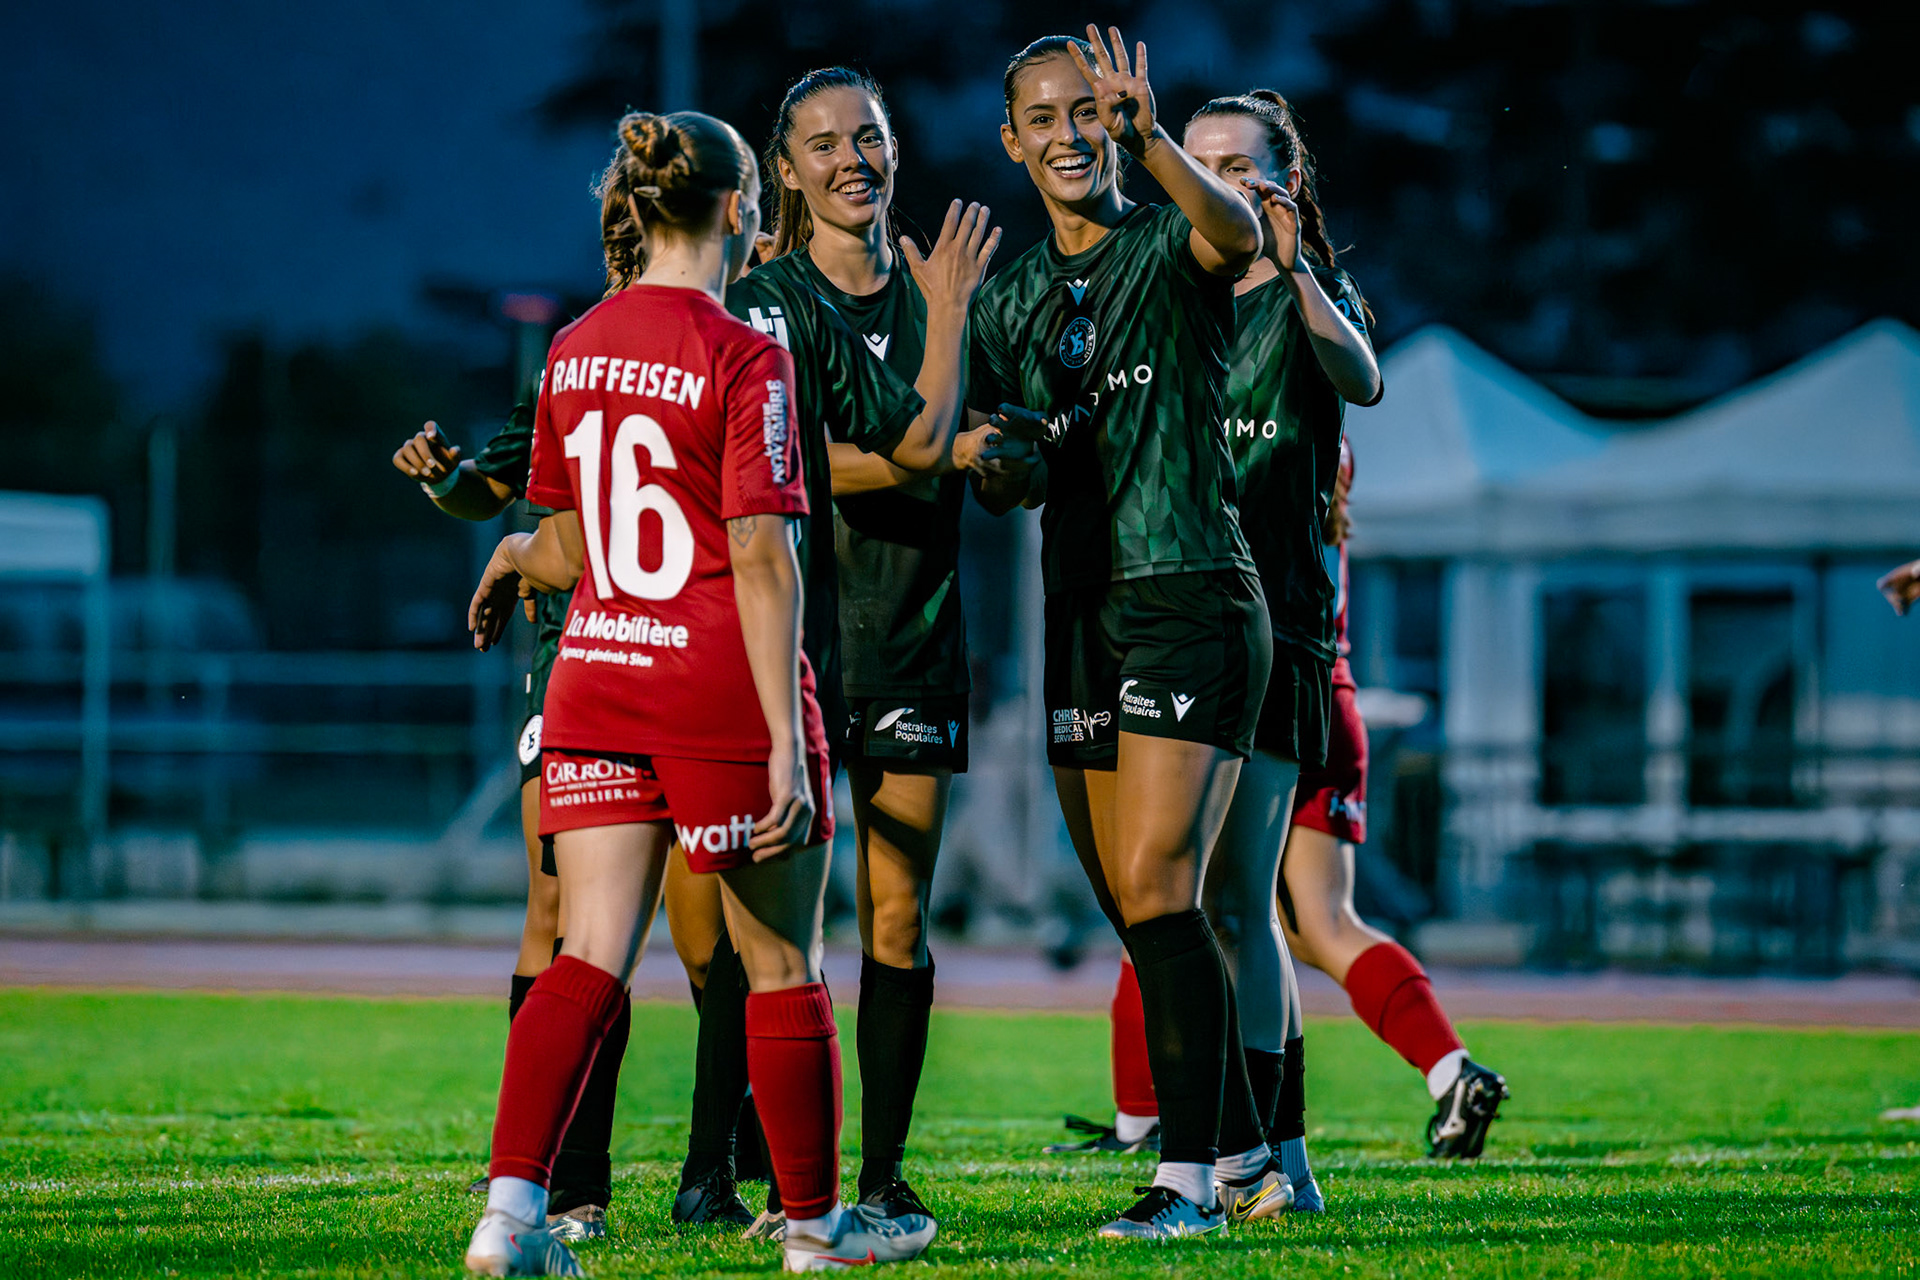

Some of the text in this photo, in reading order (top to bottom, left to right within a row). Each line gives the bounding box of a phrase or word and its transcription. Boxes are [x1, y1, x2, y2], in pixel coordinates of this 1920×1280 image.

[552, 356, 706, 411] RAIFFEISEN
[563, 409, 695, 601] 16
[565, 610, 689, 649] la Mobilière
[585, 647, 629, 665] générale
[628, 652, 653, 668] Sion
[1053, 708, 1080, 723] CHRIS
[895, 720, 938, 735] Retraites
[895, 731, 944, 745] Populaires
[1053, 723, 1083, 735] MEDICAL
[1053, 733, 1085, 744] SERVICES
[546, 759, 636, 786] CARRON
[674, 814, 756, 855] watt
